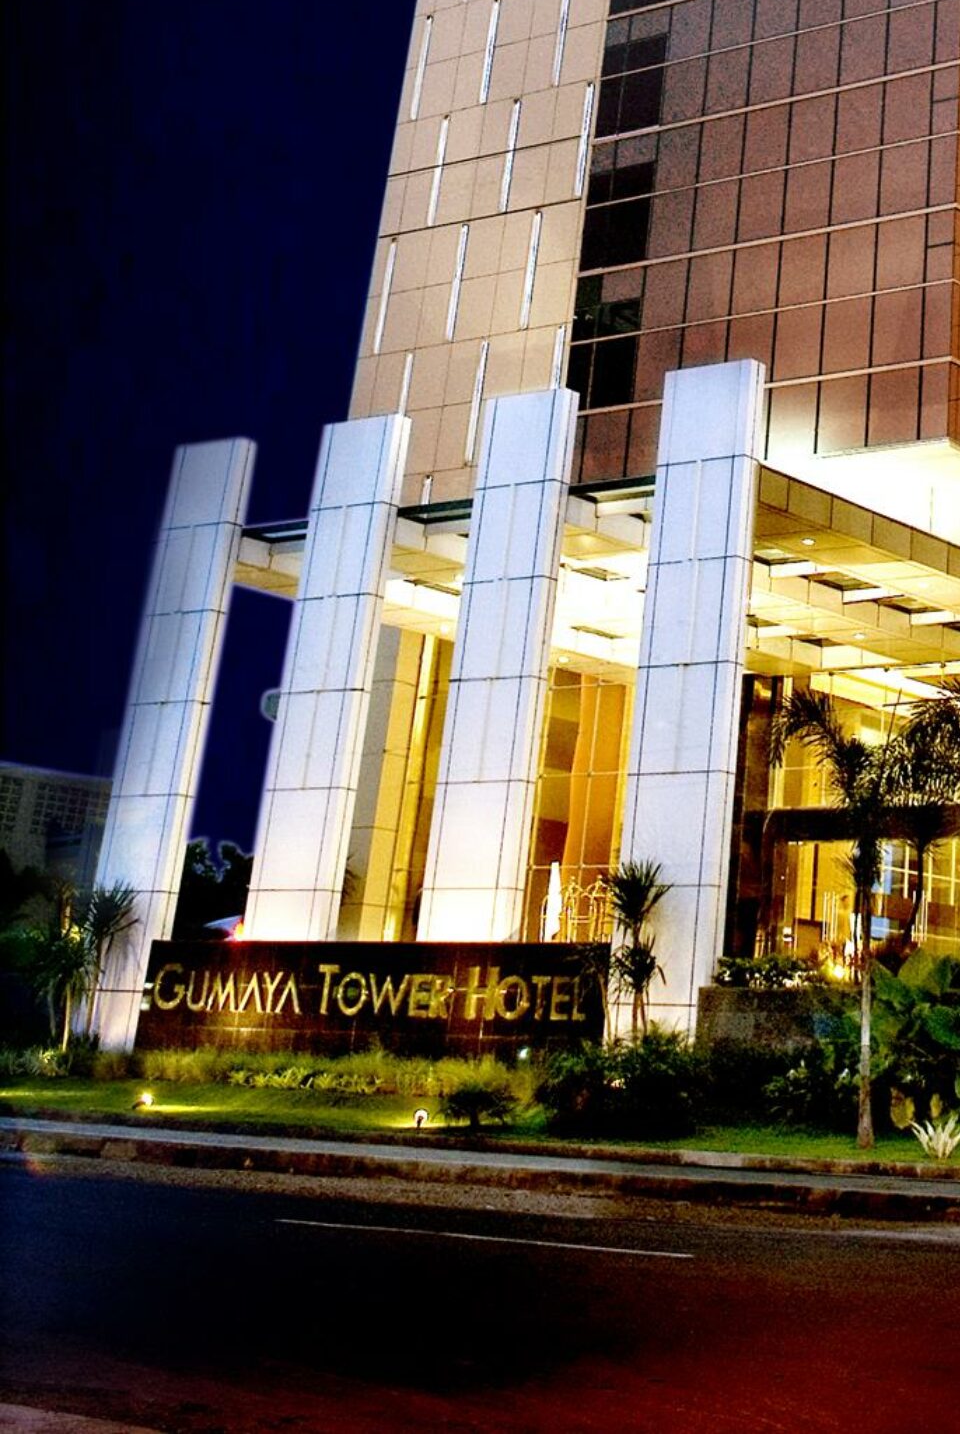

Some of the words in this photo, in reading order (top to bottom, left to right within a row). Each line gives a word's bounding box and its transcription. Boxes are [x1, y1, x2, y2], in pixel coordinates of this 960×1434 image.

[153, 963, 300, 1014] GUMAYA
[319, 963, 453, 1019] TOWER
[464, 965, 586, 1022] HOTEL
